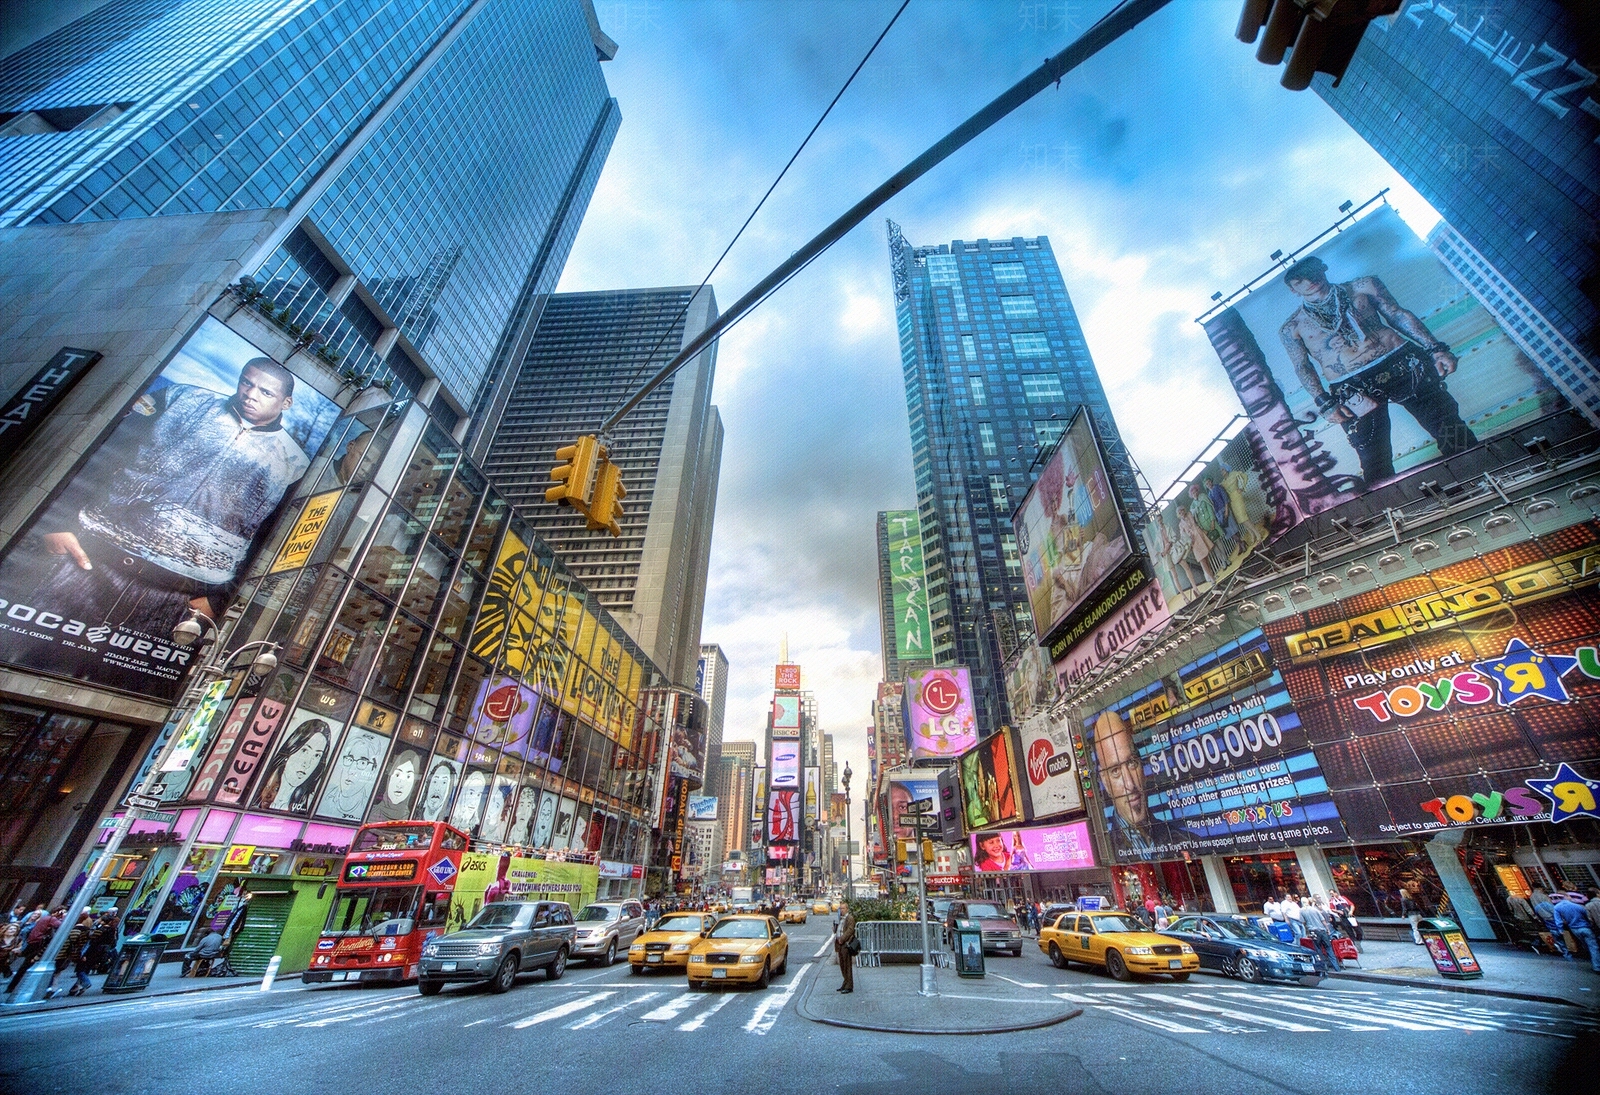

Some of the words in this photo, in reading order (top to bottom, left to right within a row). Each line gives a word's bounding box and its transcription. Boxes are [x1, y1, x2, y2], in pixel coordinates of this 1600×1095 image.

[308, 505, 328, 518] THE
[292, 520, 323, 541] LION
[281, 540, 313, 562] KING
[1052, 637, 1067, 658] BORN
[1067, 633, 1074, 645] IN
[1073, 622, 1085, 637] THE
[1084, 586, 1127, 628] GLAMOROUS
[1127, 569, 1145, 590] USA
[1294, 612, 1396, 656] DEAL
[1407, 602, 1427, 633] OR
[1429, 585, 1502, 628] NO
[10, 626, 28, 635] ALL
[29, 631, 54, 642] ODDS
[62, 639, 76, 648] DR.
[132, 629, 152, 638] RUN
[153, 636, 166, 645] THE
[167, 641, 195, 652] STRIP
[104, 652, 131, 662] JIMMY
[1344, 671, 1387, 690] Play
[1391, 659, 1436, 679] only
[1441, 650, 1465, 666] at
[1354, 671, 1493, 722] TOYS
[1133, 701, 1170, 724] DEAL
[1152, 732, 1169, 745] Play
[1170, 727, 1183, 738] for
[1185, 724, 1192, 732] a
[1193, 709, 1228, 729] chance
[1228, 703, 1242, 715] to
[1243, 694, 1267, 710] win
[413, 729, 424, 738] all
[928, 716, 961, 736] LG
[223, 705, 280, 795] PEACE
[1149, 713, 1283, 781] $1,000,000
[1030, 744, 1049, 780] Virgin
[1049, 756, 1069, 773] mobile
[1166, 787, 1174, 798] or
[1180, 782, 1194, 796] trip
[1194, 780, 1203, 791] to
[1204, 776, 1219, 790] the
[1220, 771, 1246, 786] show,
[1246, 771, 1256, 781] or
[1258, 762, 1281, 778] over
[1167, 796, 1197, 810] 100,000
[1198, 790, 1219, 803] other
[1220, 781, 1258, 800] amazing
[1259, 772, 1293, 791] prizes!
[679, 780, 689, 817] KODAK
[1421, 787, 1544, 823] TOYS
[142, 811, 173, 821] ROADWAY
[1186, 818, 1200, 830] Play
[1200, 816, 1215, 828] only
[1215, 815, 1222, 825] at
[1222, 807, 1256, 825] TOYS
[1272, 801, 1293, 818] US
[674, 819, 684, 854] digital
[1199, 836, 1235, 850] newspaper
[1235, 833, 1257, 844] insert
[1257, 831, 1269, 842] for
[1270, 833, 1277, 841] a
[1277, 828, 1303, 842] game
[1303, 825, 1333, 839] piece.
[1379, 820, 1412, 833] Subject
[1412, 821, 1422, 830] to
[470, 860, 487, 871] asics
[511, 883, 541, 892] WATCHING
[541, 883, 560, 892] OTHERS
[561, 883, 572, 892] PASS
[572, 883, 582, 892] YOU
